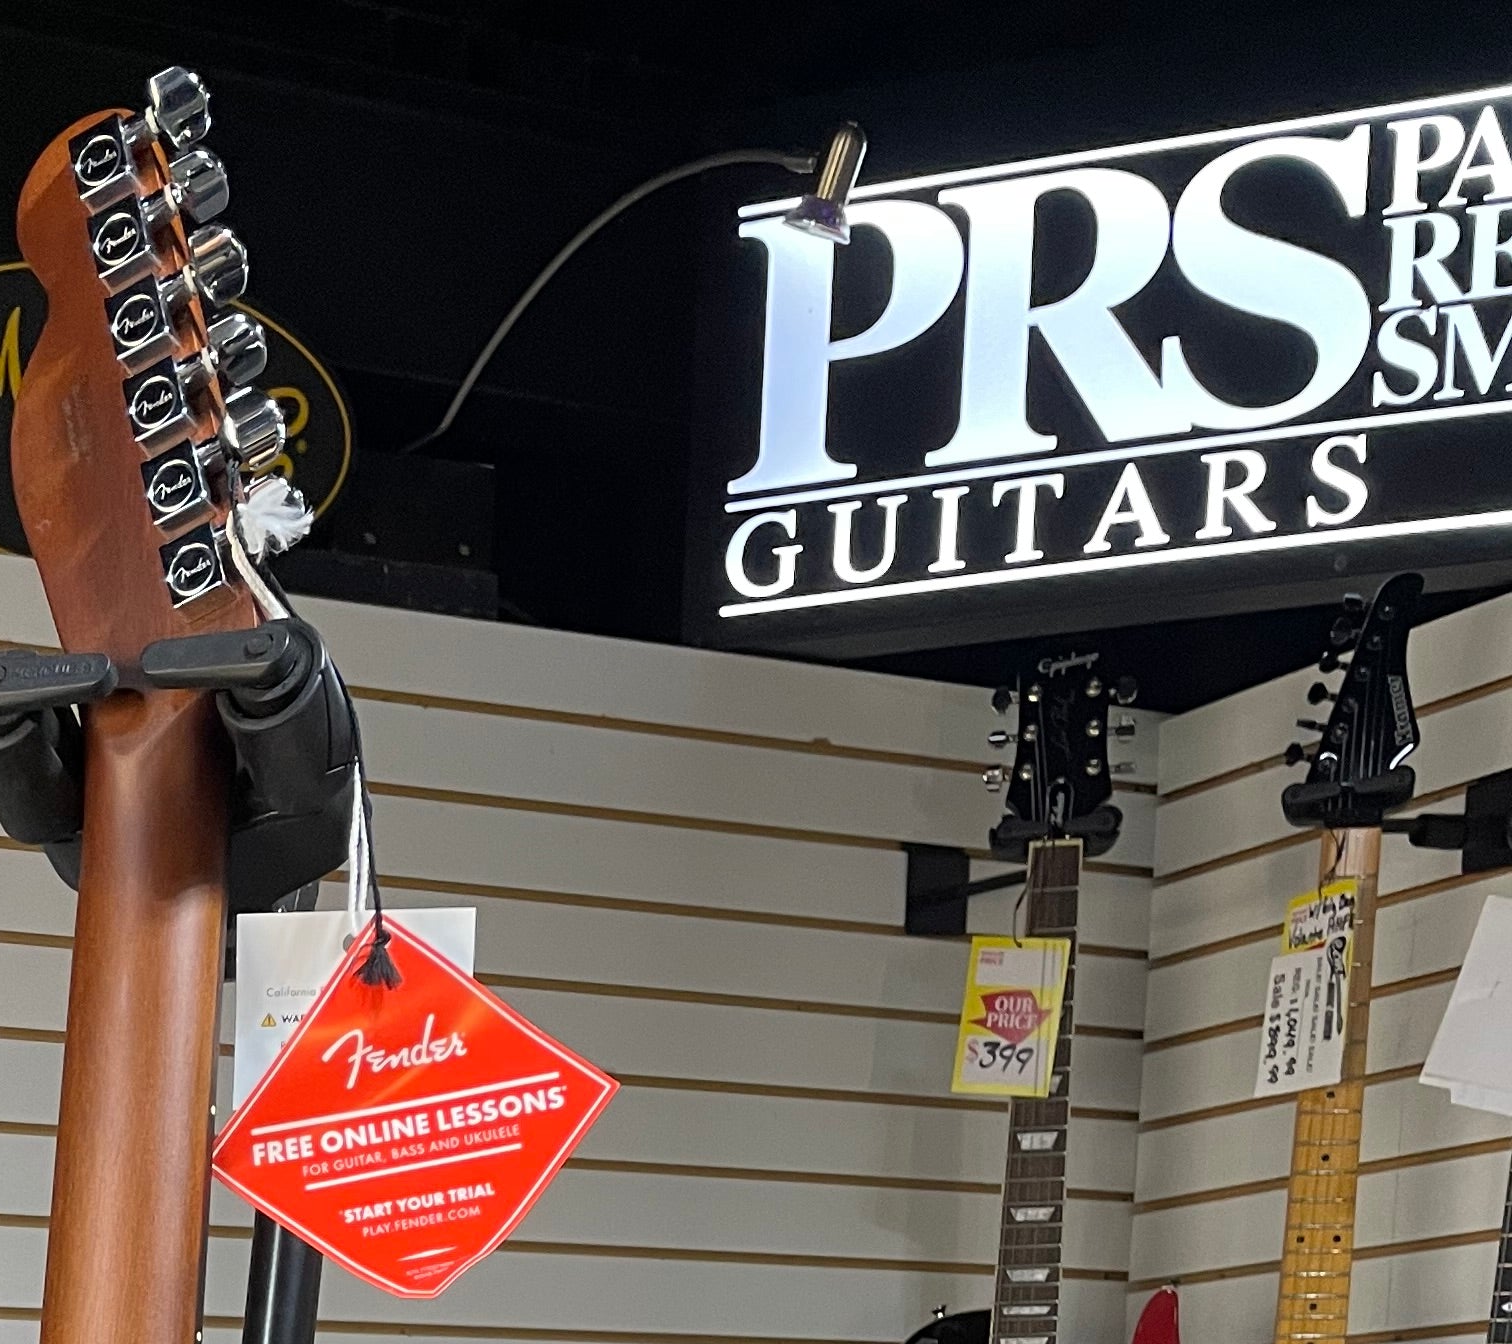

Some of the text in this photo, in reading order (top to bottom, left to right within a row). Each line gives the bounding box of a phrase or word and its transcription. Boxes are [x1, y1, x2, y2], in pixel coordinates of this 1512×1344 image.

[80, 147, 117, 173] Fender
[100, 228, 136, 253] Fender
[728, 124, 1372, 494] PRS
[119, 310, 155, 334] Fender
[137, 391, 173, 416] Fender
[155, 474, 192, 499] Fender
[724, 433, 1371, 598] GUITARS
[174, 558, 211, 583] Fender
[266, 986, 317, 998] California
[994, 995, 1033, 1013] OUR
[986, 1011, 1037, 1030] PRICE
[322, 1014, 467, 1090] Fender
[251, 1135, 314, 1166] FREE
[320, 1113, 430, 1153] ONLINE
[302, 1123, 520, 1178] FOR GUITAR, BASS AND UKULELE
[396, 1193, 445, 1213] YOUR
[448, 1182, 495, 1203] TRIAL
[362, 1205, 481, 1238] PLAY.FENDER.COM
